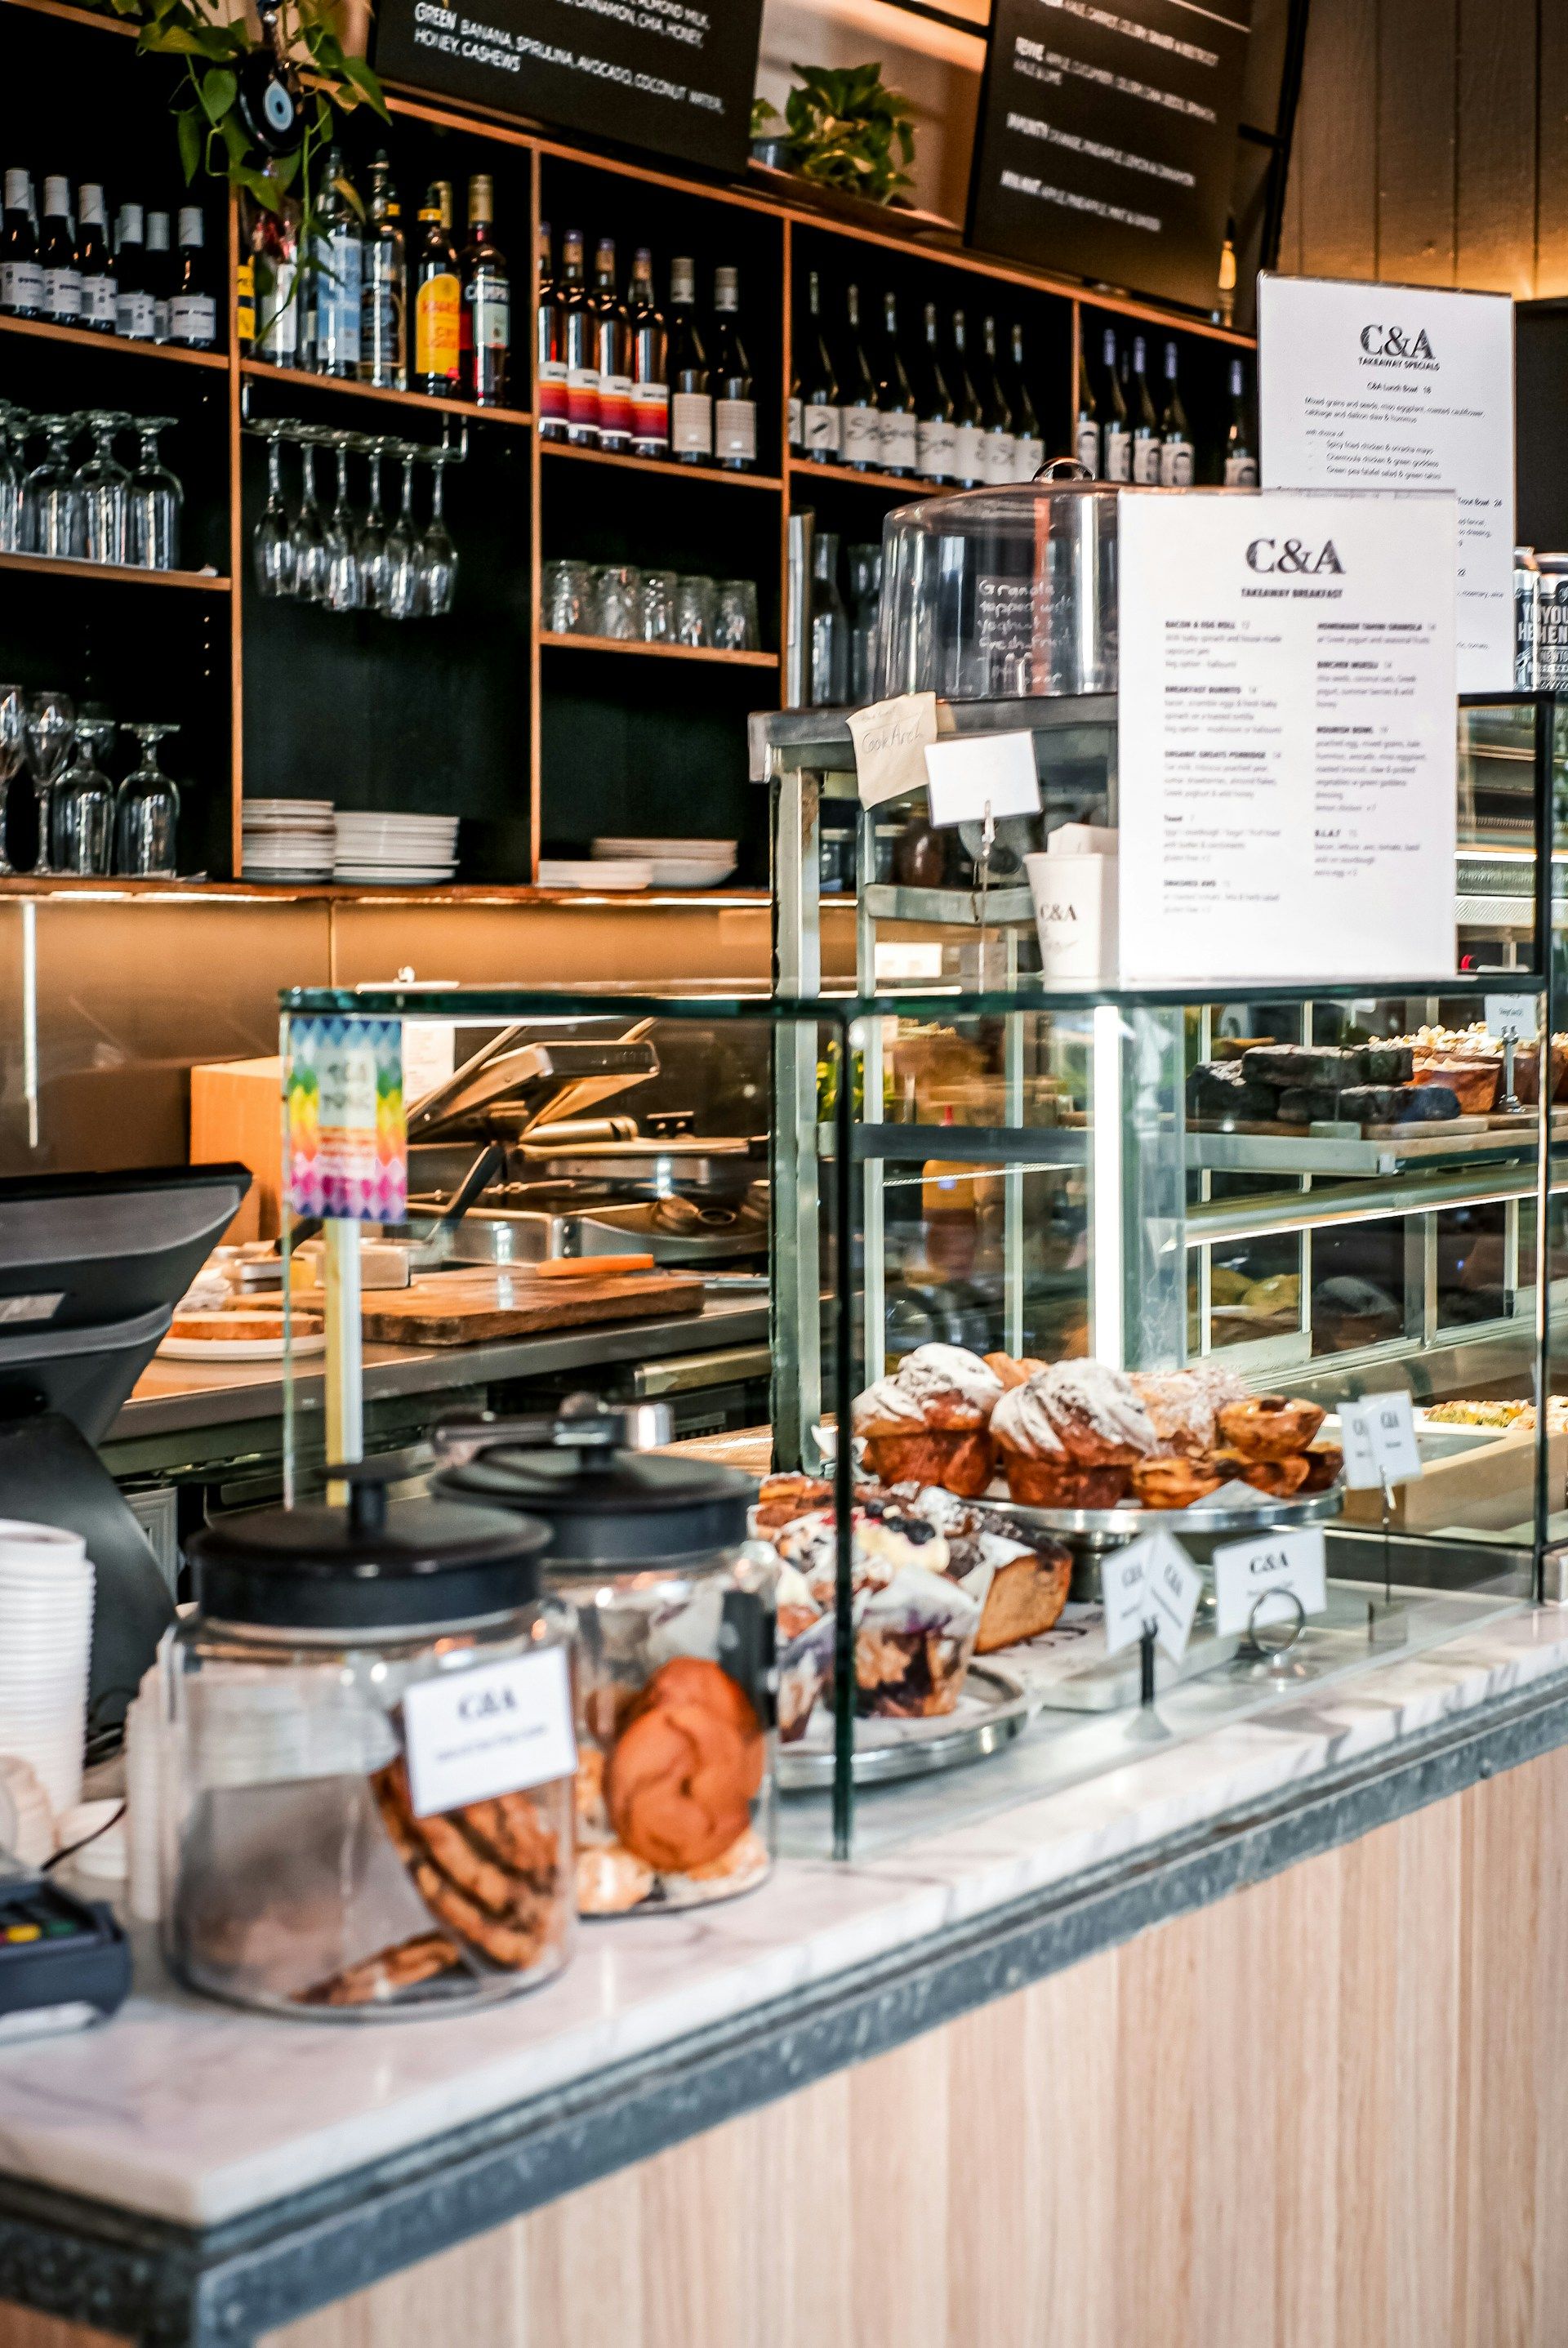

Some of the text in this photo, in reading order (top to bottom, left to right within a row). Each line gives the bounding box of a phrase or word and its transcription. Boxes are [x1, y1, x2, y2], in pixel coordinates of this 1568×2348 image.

[414, 2, 457, 30] GREEN
[461, 42, 522, 74] CASHEWS
[1359, 323, 1437, 360] C&A
[1245, 537, 1346, 575] C&A
[1039, 903, 1077, 922] C&A
[1249, 1551, 1290, 1575] C&A
